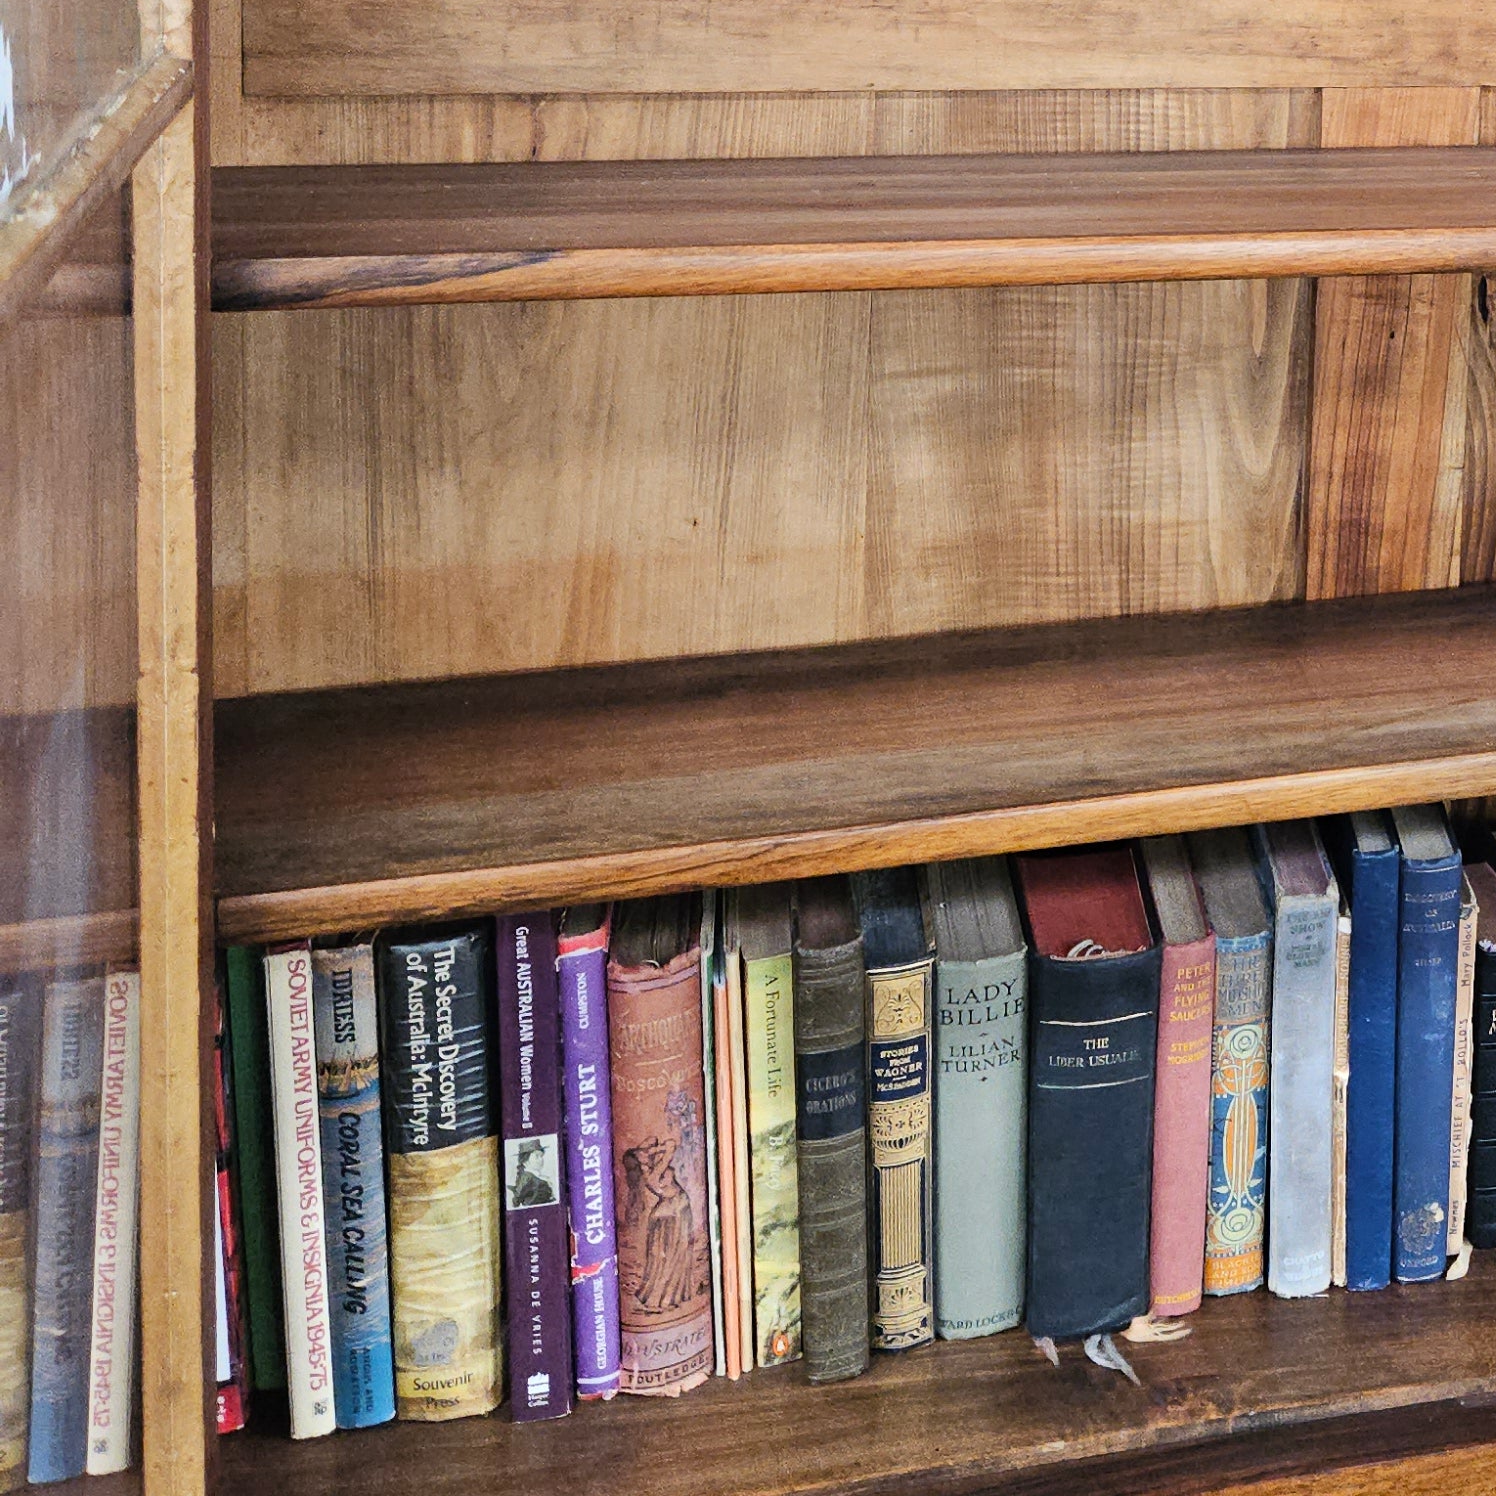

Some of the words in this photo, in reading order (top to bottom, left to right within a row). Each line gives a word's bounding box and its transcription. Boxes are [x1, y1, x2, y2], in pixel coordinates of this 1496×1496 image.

[515, 926, 530, 960] Great
[1462, 923, 1473, 957] Pollock
[406, 953, 427, 973] of
[433, 946, 456, 982] The
[764, 974, 774, 987] A
[1177, 961, 1212, 980] PETER
[1461, 963, 1473, 987] Mary
[287, 958, 309, 1033] SOVIET
[517, 962, 534, 1042] AUSTRALIAN
[575, 972, 589, 1029] CUMPSTON
[947, 977, 1019, 1005] LADY
[1173, 981, 1196, 993] AND
[332, 968, 356, 1044] IDRIESS
[407, 975, 432, 1061] Australia:
[435, 984, 457, 1044] Secret
[939, 995, 1025, 1026] BILLIE
[765, 990, 780, 1065] Fortunate
[1083, 1037, 1110, 1050] THE
[880, 1044, 919, 1059] STORIES
[941, 1048, 1021, 1074] TURNER
[949, 1035, 1015, 1058] LILIAN
[1048, 1055, 1085, 1068] LIBER
[1088, 1049, 1142, 1067] USUALI
[291, 1035, 313, 1094] ARMY
[520, 1044, 534, 1090] Women
[875, 1061, 923, 1078] WAGNER
[438, 1044, 461, 1131] Discovery
[577, 1063, 598, 1135] STURT
[767, 1067, 782, 1099] Life
[410, 1063, 433, 1145] McIntyre
[806, 1090, 858, 1115] ORATIONS
[1456, 1096, 1464, 1107] AT
[295, 1099, 318, 1210] UNIFORMS
[338, 1112, 361, 1177] CORAL
[1452, 1116, 1463, 1168] MISCHIEF
[341, 1182, 364, 1221] SEA
[583, 1145, 606, 1245] CHARLES
[301, 1213, 319, 1228] &
[1449, 1200, 1459, 1234] Newnes
[528, 1218, 540, 1284] SUSANNA
[302, 1229, 325, 1321] INSIGNIA
[342, 1226, 367, 1315] CALLING
[531, 1290, 541, 1308] DE
[592, 1276, 605, 1311] HOUSE
[531, 1314, 543, 1355] VRIES
[593, 1311, 607, 1370] GEORGIAN
[412, 1370, 474, 1391] Souvenir
[425, 1395, 461, 1409] Press
